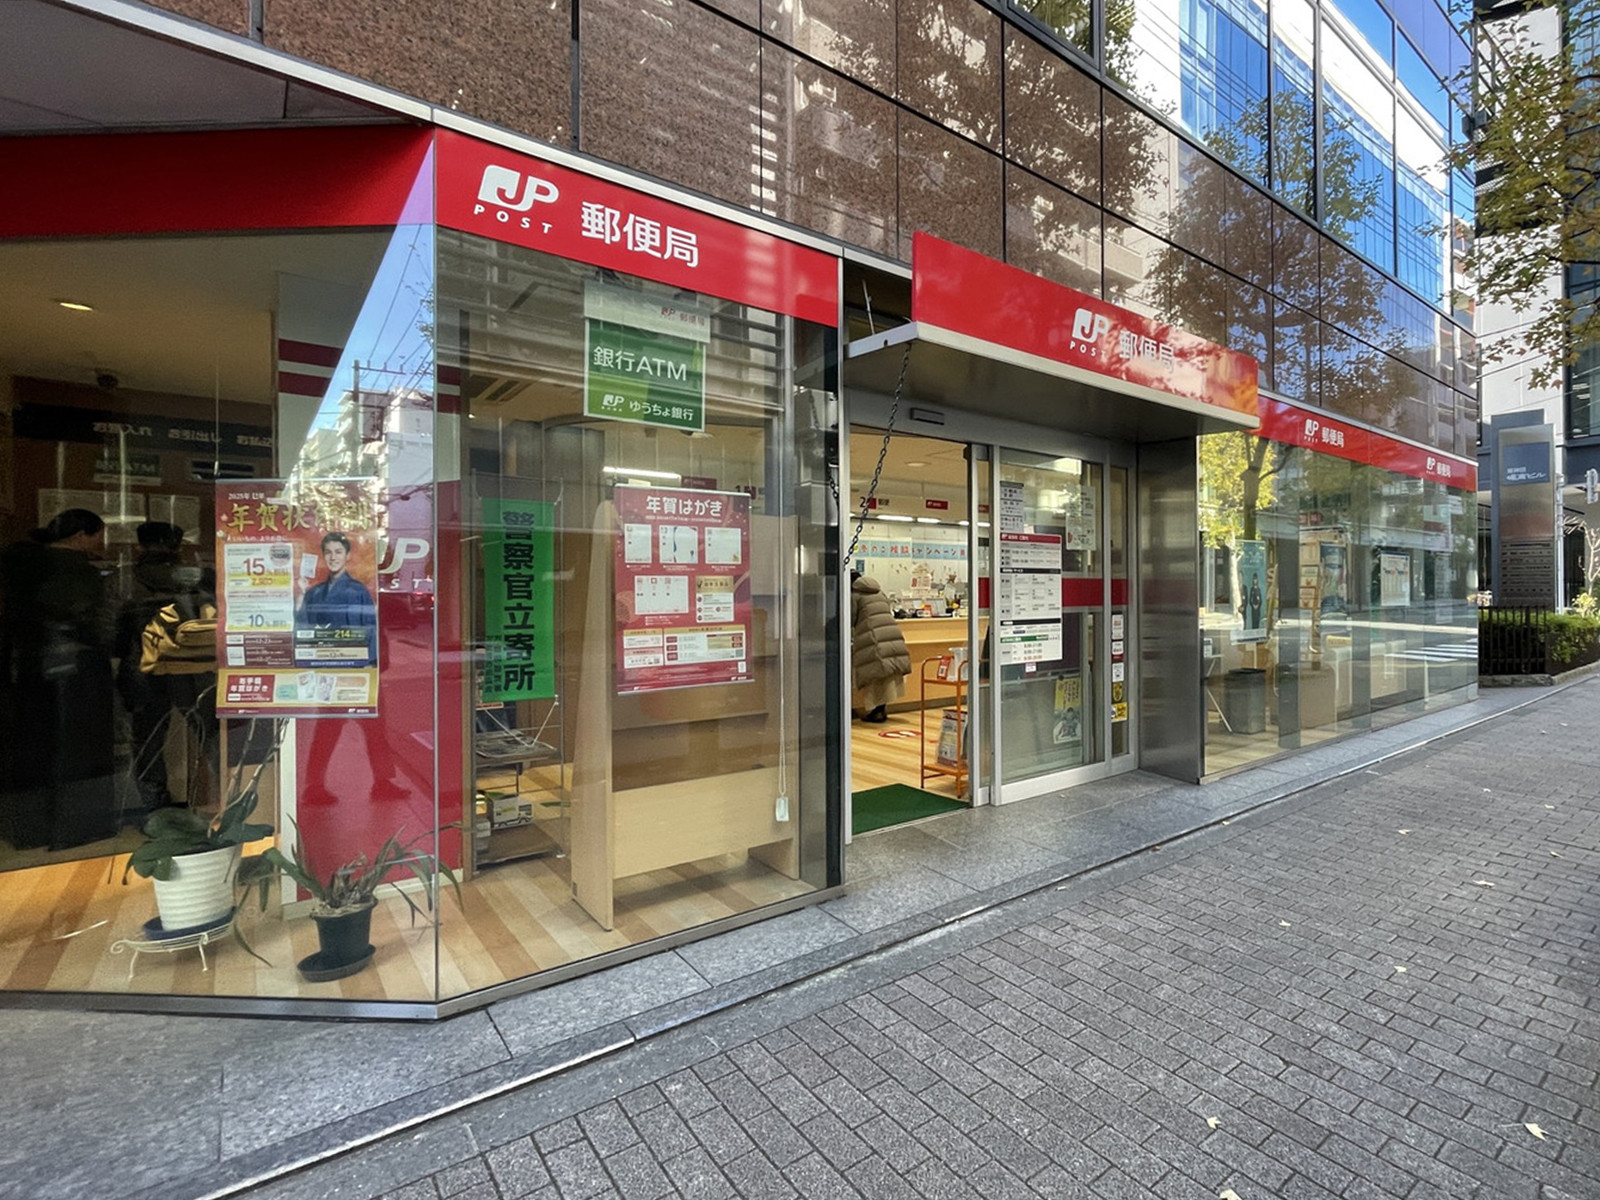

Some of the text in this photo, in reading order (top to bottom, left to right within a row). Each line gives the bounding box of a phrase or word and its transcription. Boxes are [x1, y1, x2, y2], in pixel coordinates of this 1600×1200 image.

[474, 204, 553, 234] POST
[581, 201, 699, 268] 郵便局
[593, 346, 687, 382] 銀行ATM
[1069, 341, 1108, 358] POST
[1119, 329, 1175, 373] 郵便局
[629, 400, 694, 421] ゆうちょ銀行
[1321, 427, 1345, 448] 郵便局
[646, 496, 723, 517] 年賀はがき
[502, 511, 535, 691] 警察官立寄所
